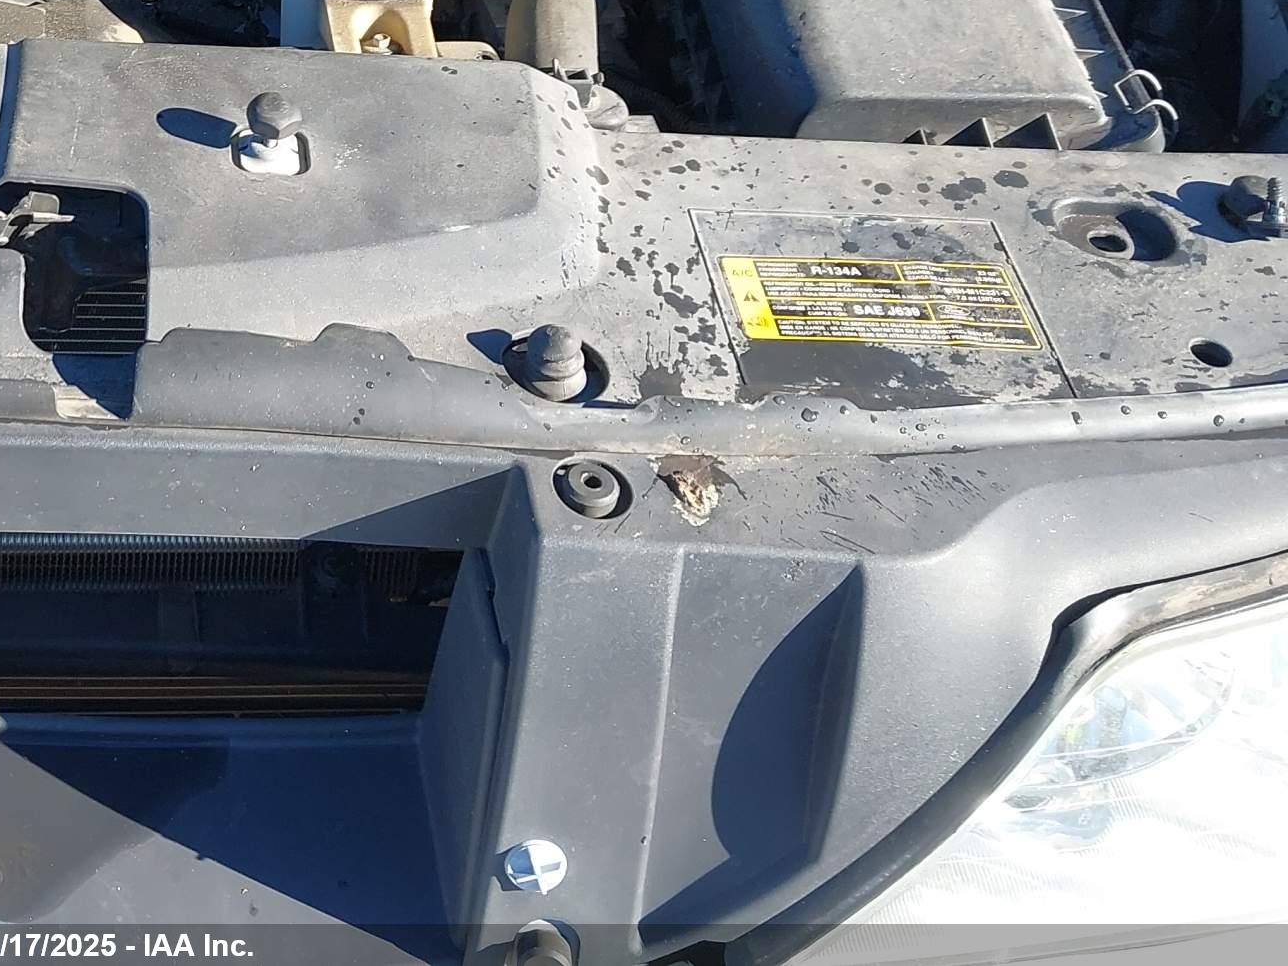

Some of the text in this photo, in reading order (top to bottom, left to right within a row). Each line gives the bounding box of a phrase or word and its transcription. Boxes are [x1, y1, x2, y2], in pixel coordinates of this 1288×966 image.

[810, 265, 863, 276] R-134A
[852, 305, 921, 317] SAE J639
